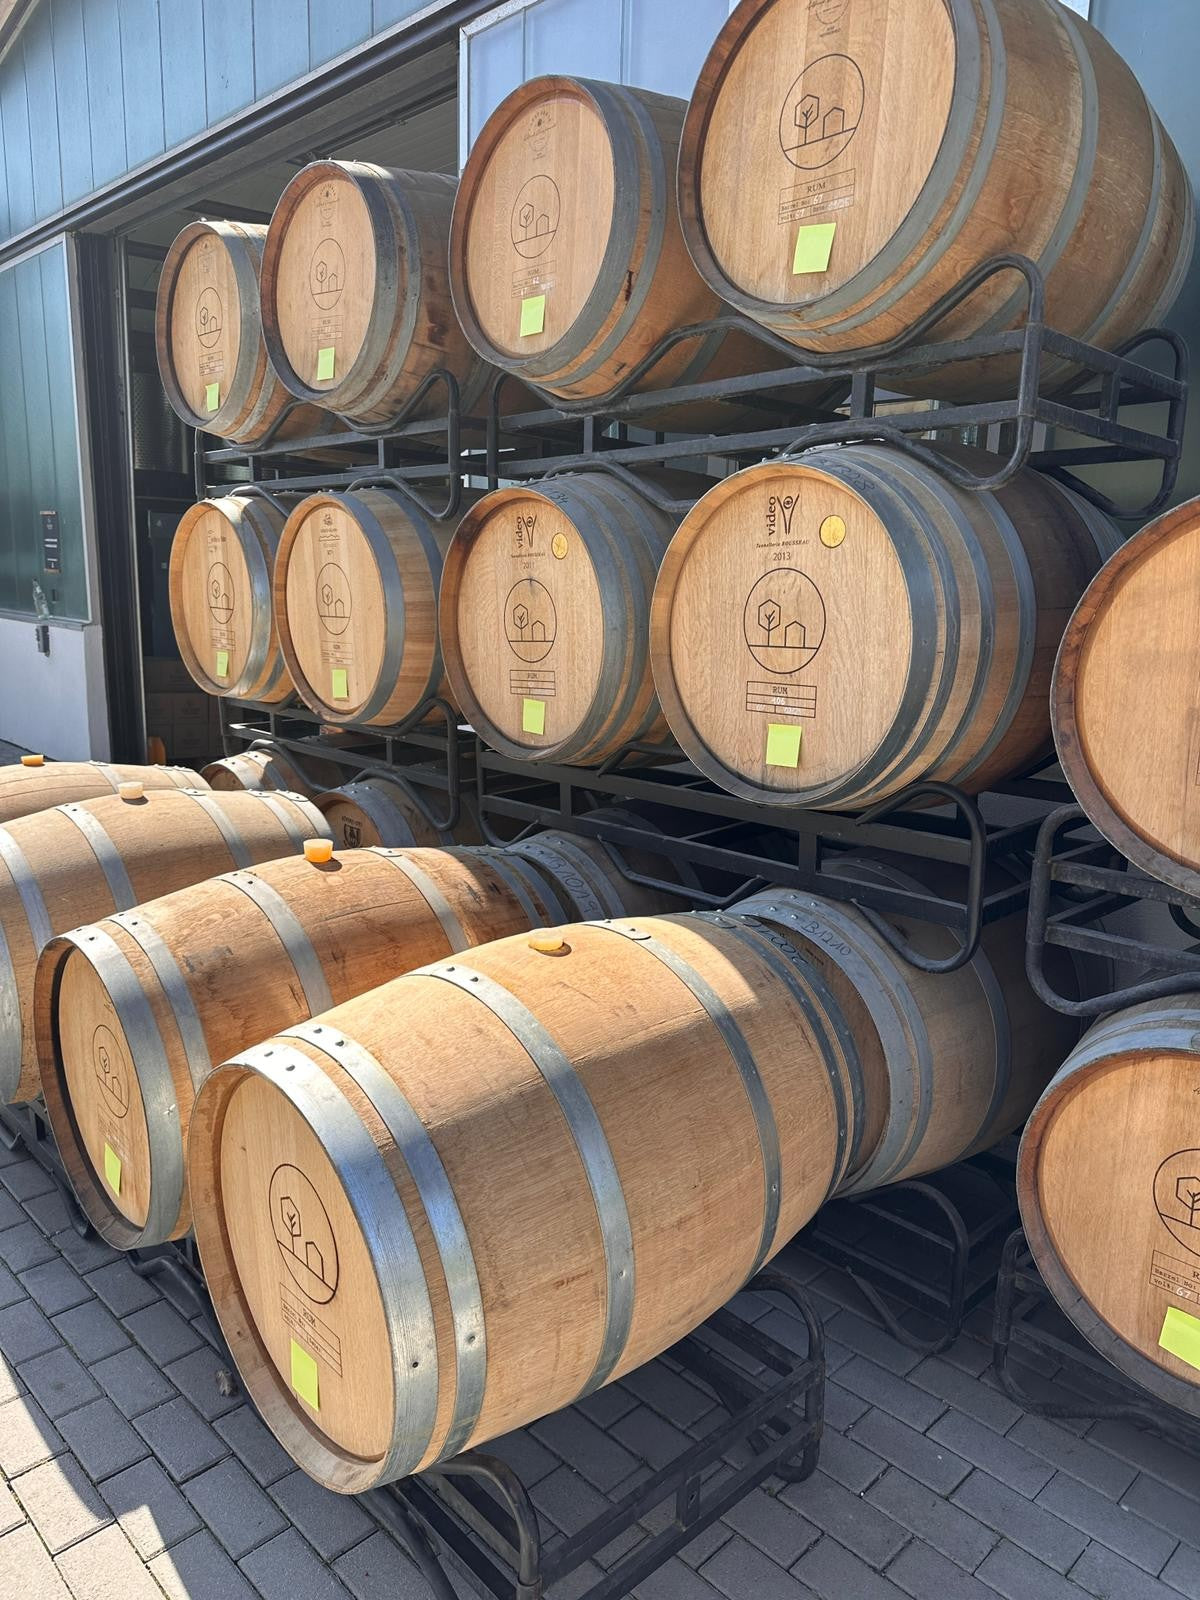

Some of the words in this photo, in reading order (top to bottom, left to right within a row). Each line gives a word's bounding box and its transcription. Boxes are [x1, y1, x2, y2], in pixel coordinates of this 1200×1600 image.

[807, 182, 826, 193] RUM
[766, 496, 776, 536] video
[515, 516, 524, 548] video
[773, 551, 791, 561] 2013
[772, 686, 788, 695] RUM
